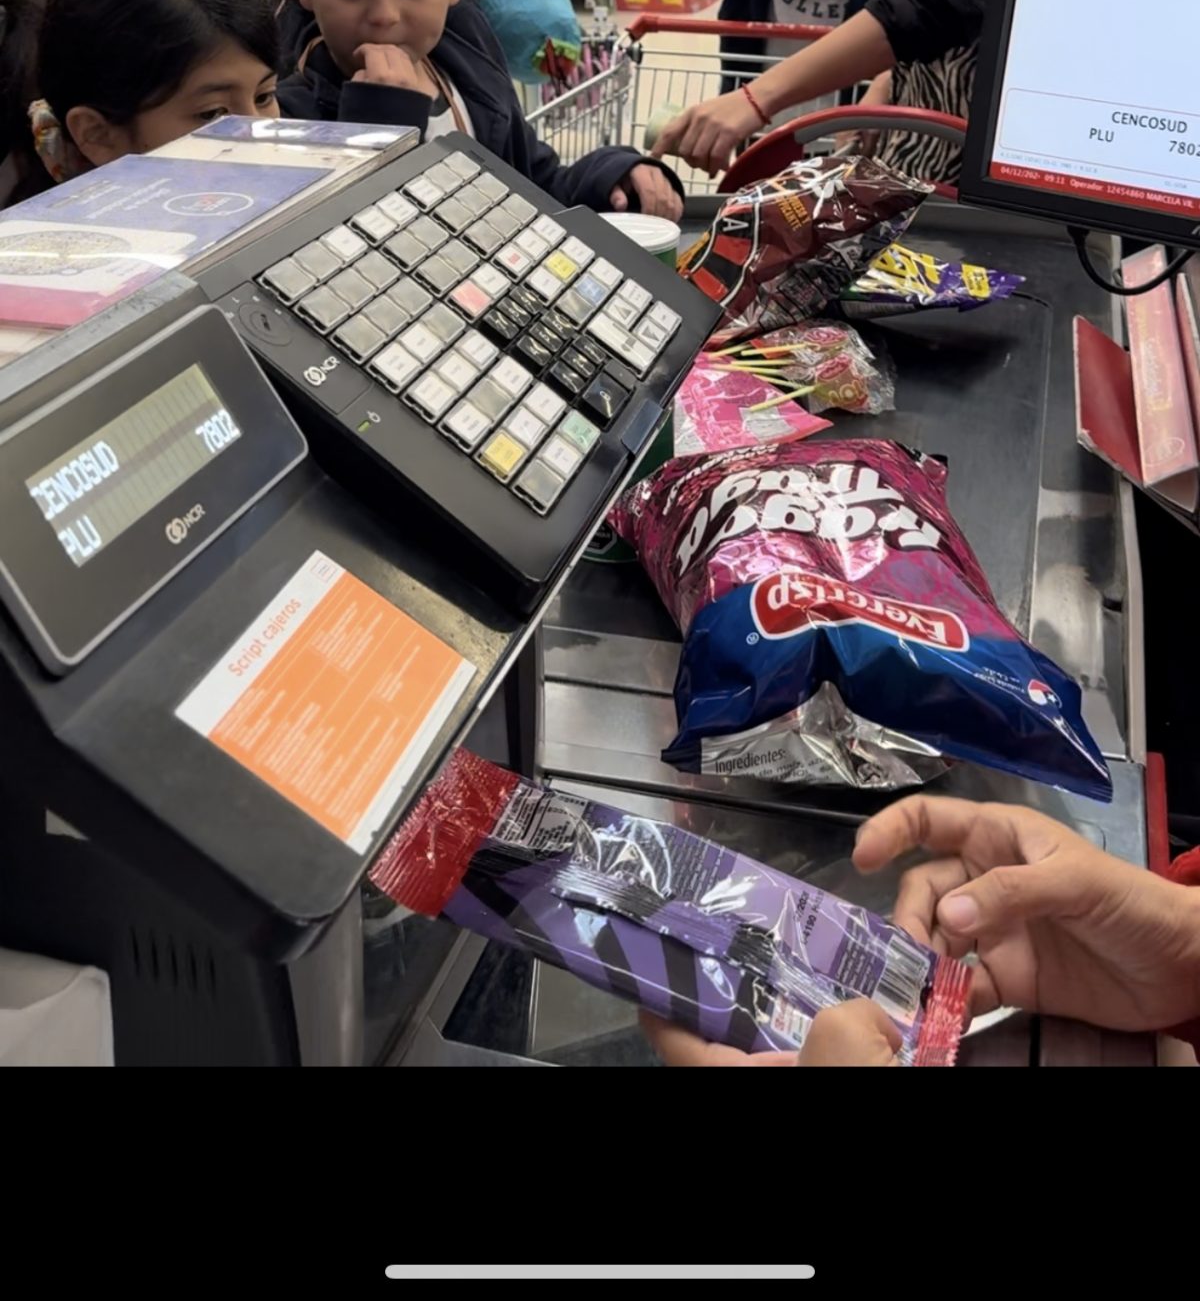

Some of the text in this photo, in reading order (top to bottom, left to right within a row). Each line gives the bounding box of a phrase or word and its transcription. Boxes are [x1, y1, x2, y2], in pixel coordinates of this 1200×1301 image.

[1088, 127, 1115, 143] PLU
[1111, 110, 1188, 134] CENCOSUD
[319, 355, 341, 375] NCR
[29, 439, 120, 522] CENCOSUD
[57, 407, 241, 559] PLU 7802
[182, 502, 207, 529] NCR
[227, 597, 302, 678] Script cajeros
[714, 747, 787, 774] Ingredientes:
